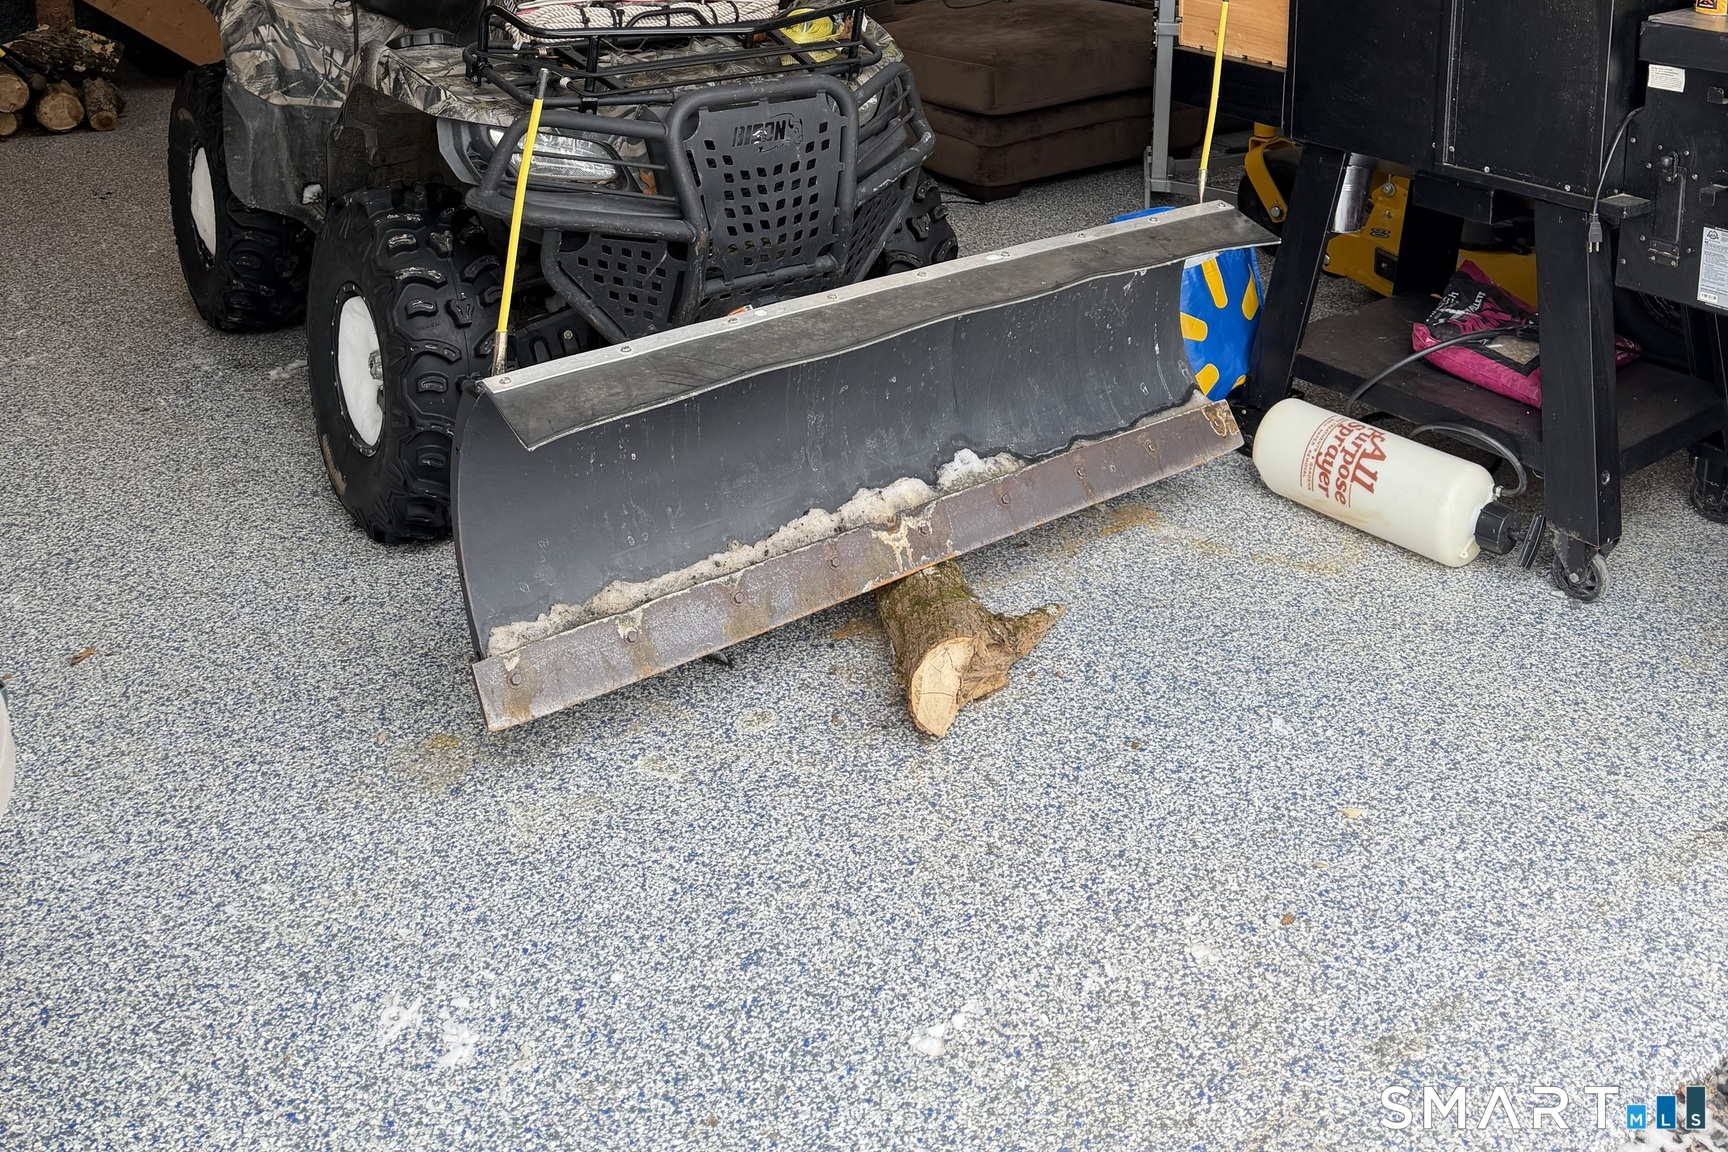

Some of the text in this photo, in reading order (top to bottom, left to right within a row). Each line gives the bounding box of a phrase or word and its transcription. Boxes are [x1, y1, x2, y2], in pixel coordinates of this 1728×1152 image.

[1315, 421, 1366, 498] Sprayer
[1334, 427, 1386, 505] Purpose
[1350, 432, 1387, 494] All
